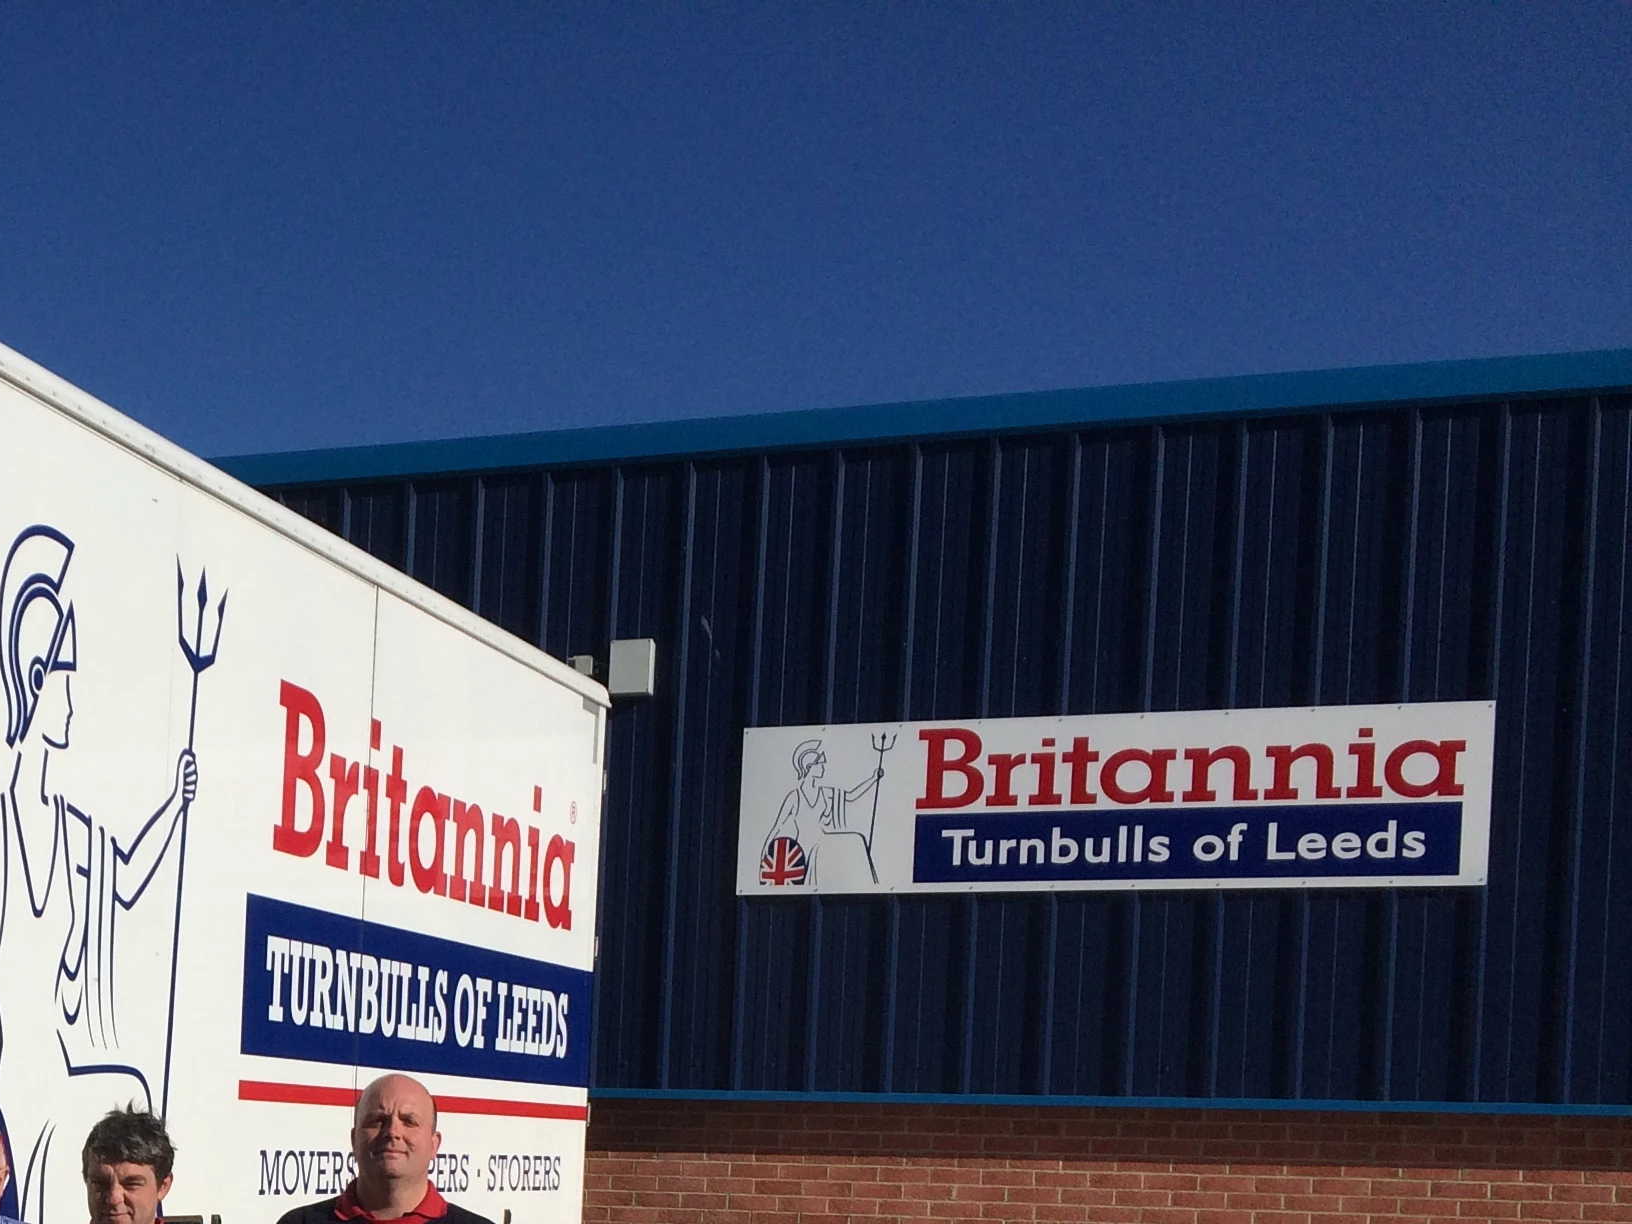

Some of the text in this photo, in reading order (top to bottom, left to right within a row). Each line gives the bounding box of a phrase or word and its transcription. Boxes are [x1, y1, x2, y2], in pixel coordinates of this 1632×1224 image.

[272, 679, 576, 931] Britannia
[915, 727, 1466, 810] Britannia
[942, 820, 1427, 866] Turnbulls of Leeds
[266, 935, 569, 1059] TURNBULLS OF LEEDS
[258, 1150, 356, 1195] MOVERS
[486, 1154, 562, 1193] STORERS
